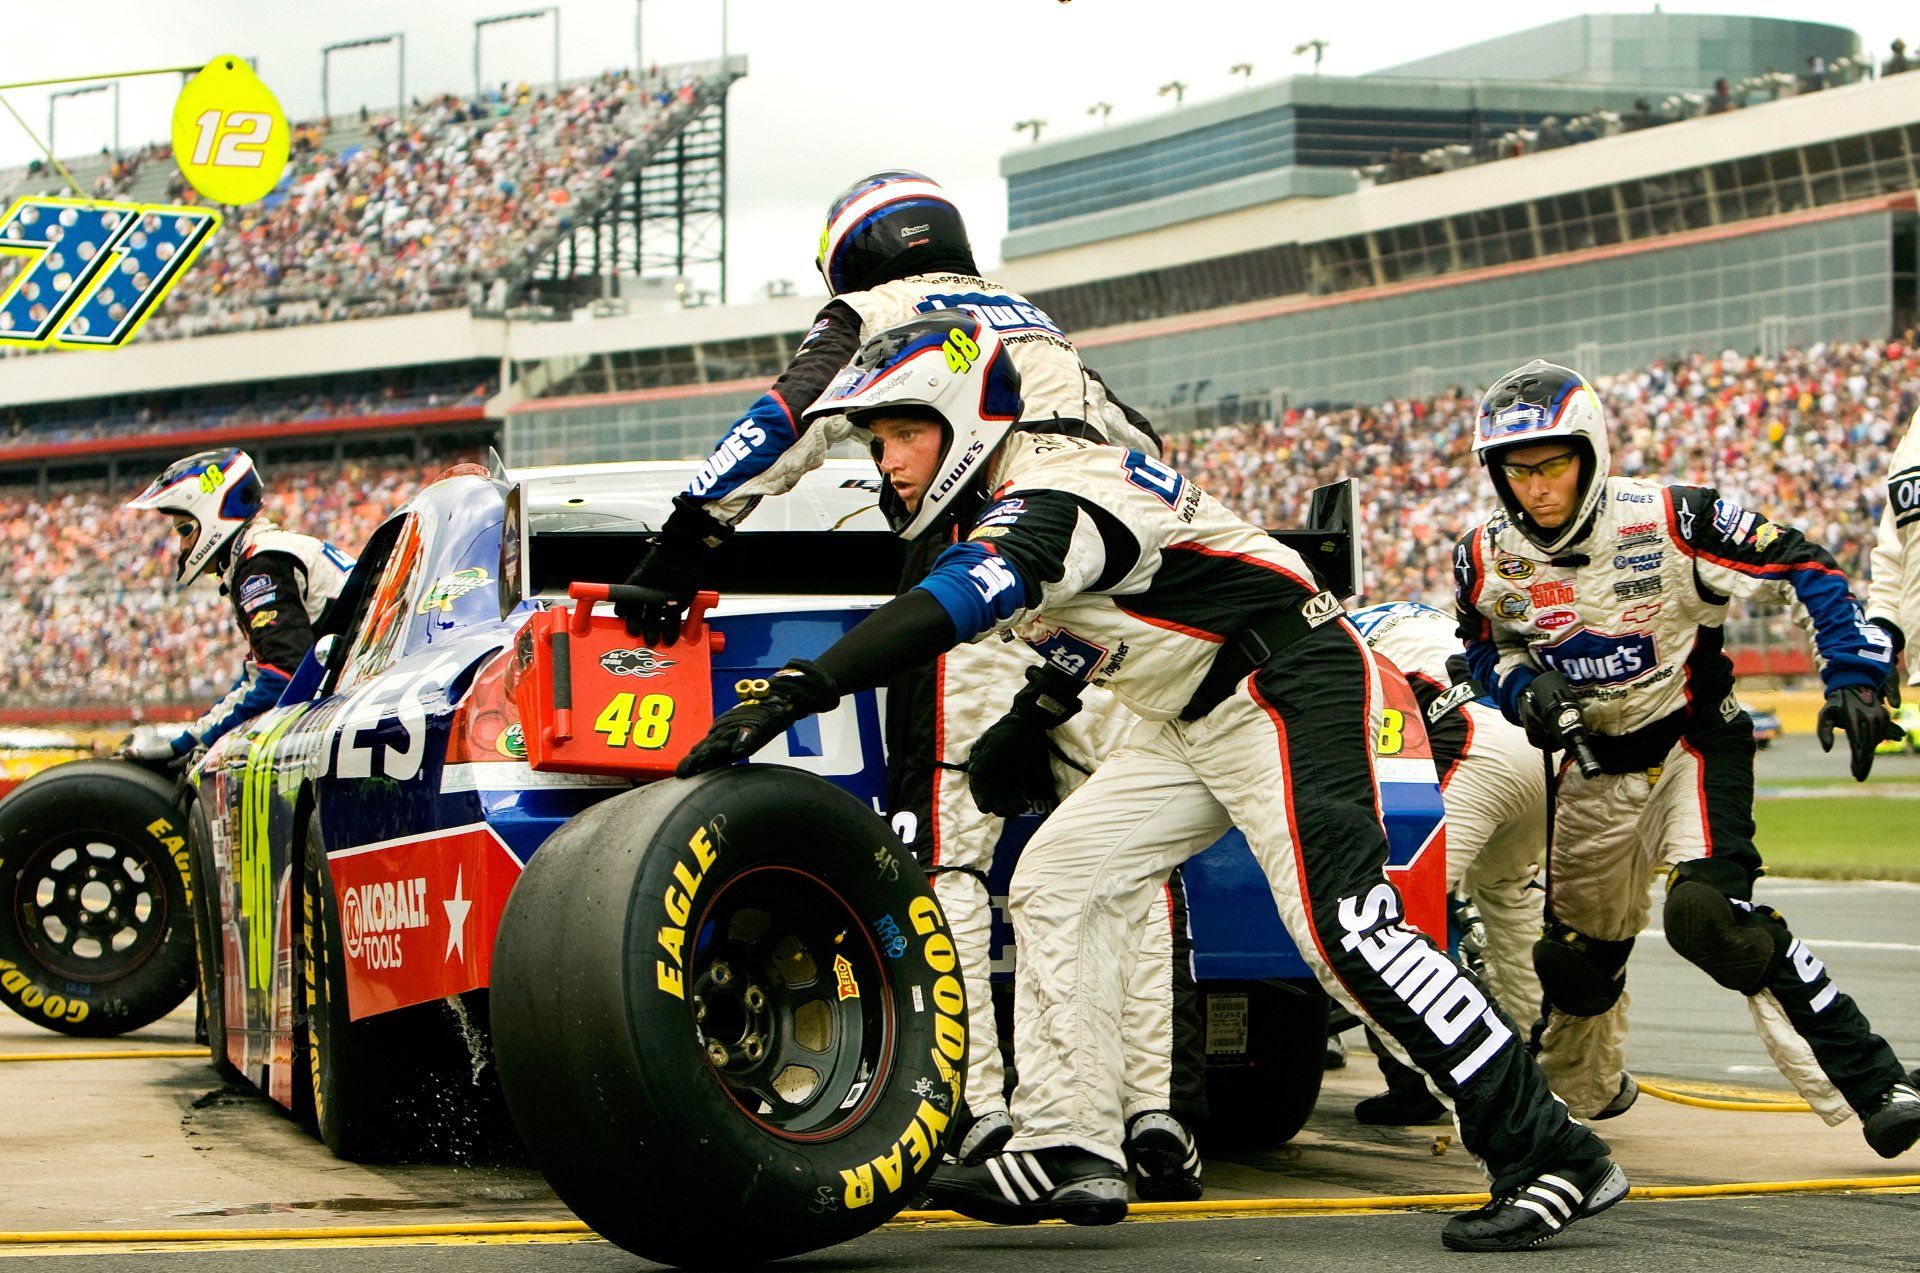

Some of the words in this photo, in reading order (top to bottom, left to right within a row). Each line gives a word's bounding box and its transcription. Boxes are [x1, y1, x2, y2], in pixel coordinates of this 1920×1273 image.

[191, 109, 273, 168] 12
[942, 328, 981, 374] 48
[199, 464, 225, 494] 48
[689, 418, 767, 496] LOWE'S
[930, 440, 984, 502] LOWE'S
[189, 531, 223, 566] LOWE'S
[1529, 586, 1575, 608] GUARD
[1537, 615, 1575, 626] DELPHI
[1099, 641, 1130, 678] Together
[1632, 664, 1675, 691] Together
[594, 693, 676, 750] 48
[146, 817, 194, 908] EAGLE
[361, 878, 427, 934] KOBALT
[656, 826, 717, 1000] EAGLE
[364, 934, 402, 969] TOOLS
[840, 963, 853, 993] AERO
[1338, 883, 1513, 1086] LOWE'S
[839, 895, 966, 1209] GOODYEAR
